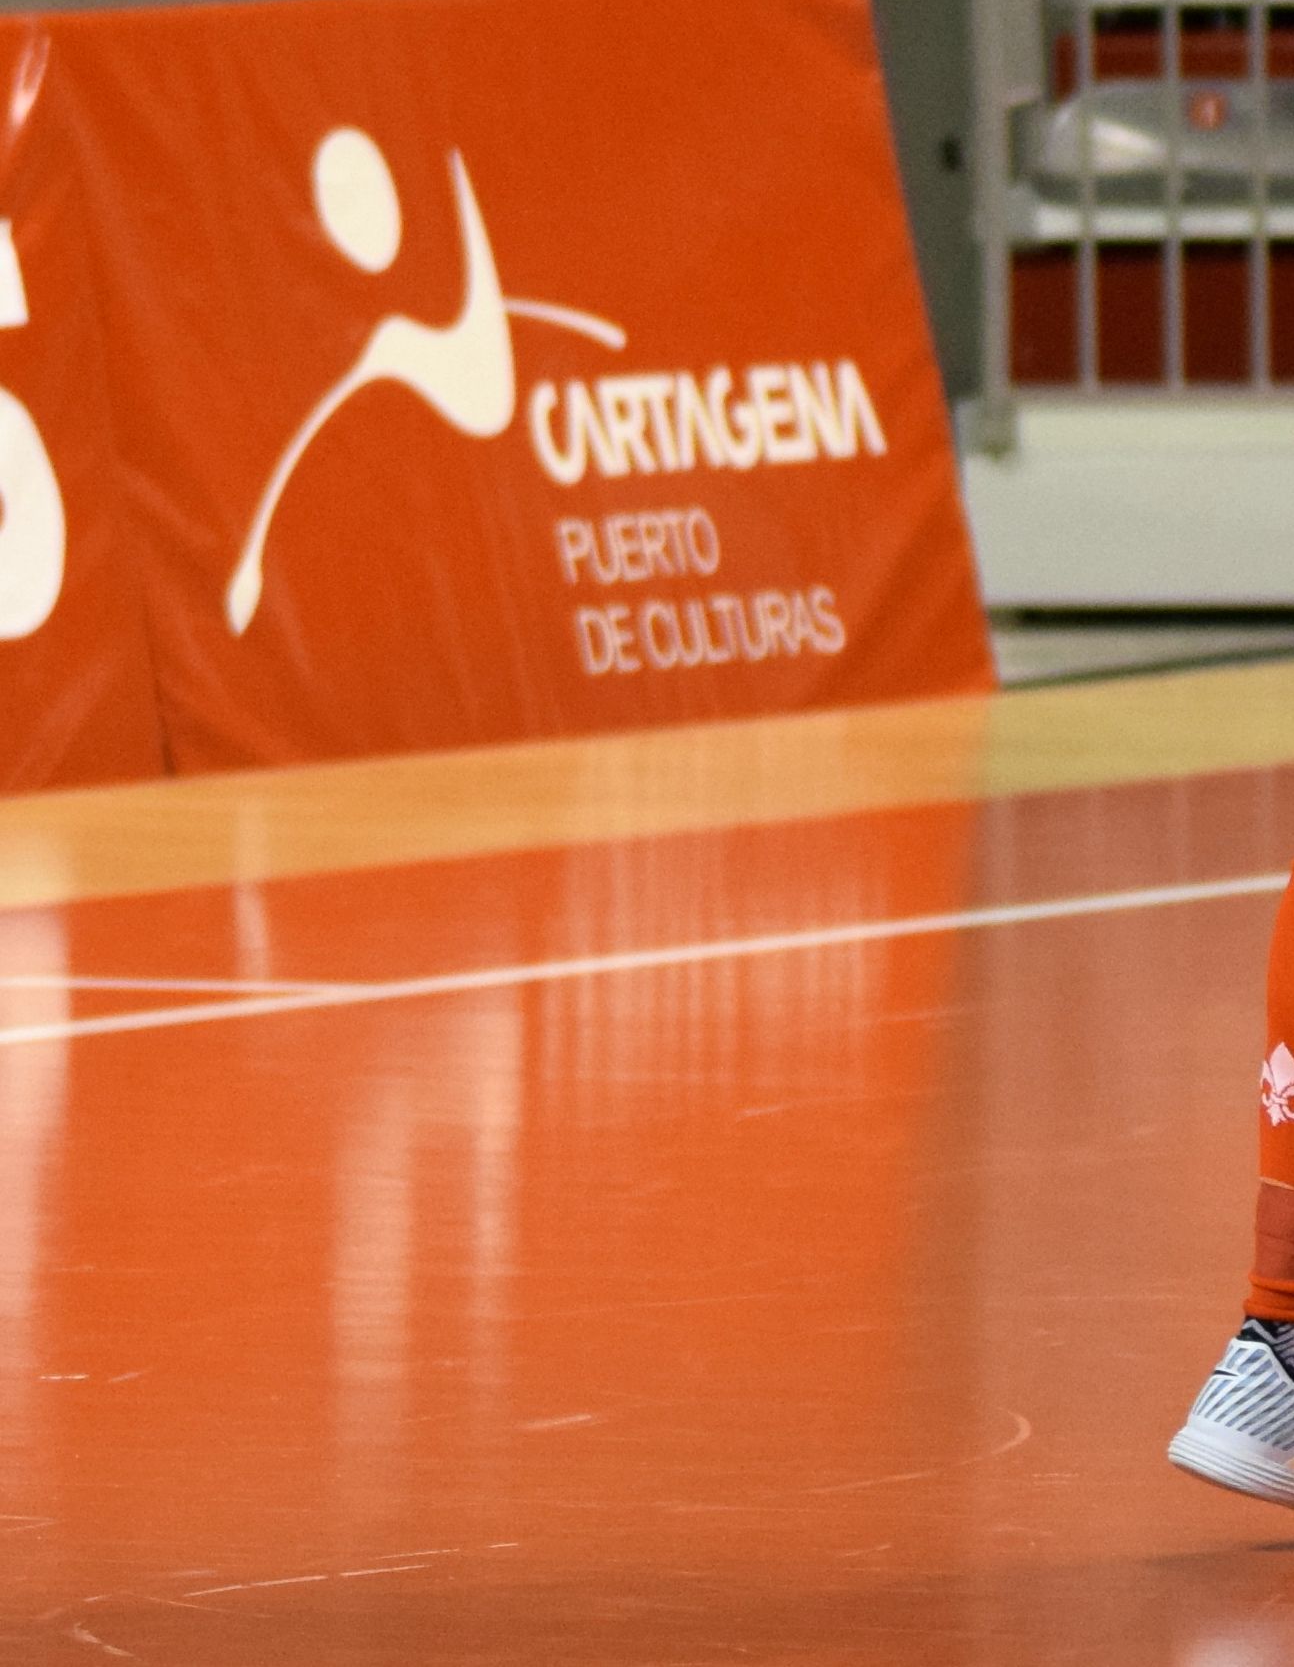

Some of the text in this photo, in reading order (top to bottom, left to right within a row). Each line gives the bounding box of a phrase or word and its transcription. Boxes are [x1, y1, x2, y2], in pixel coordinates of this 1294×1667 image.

[528, 357, 889, 485] CARTAGENA
[556, 505, 721, 585] PUERTO
[576, 586, 847, 675] DE CULTURAS
